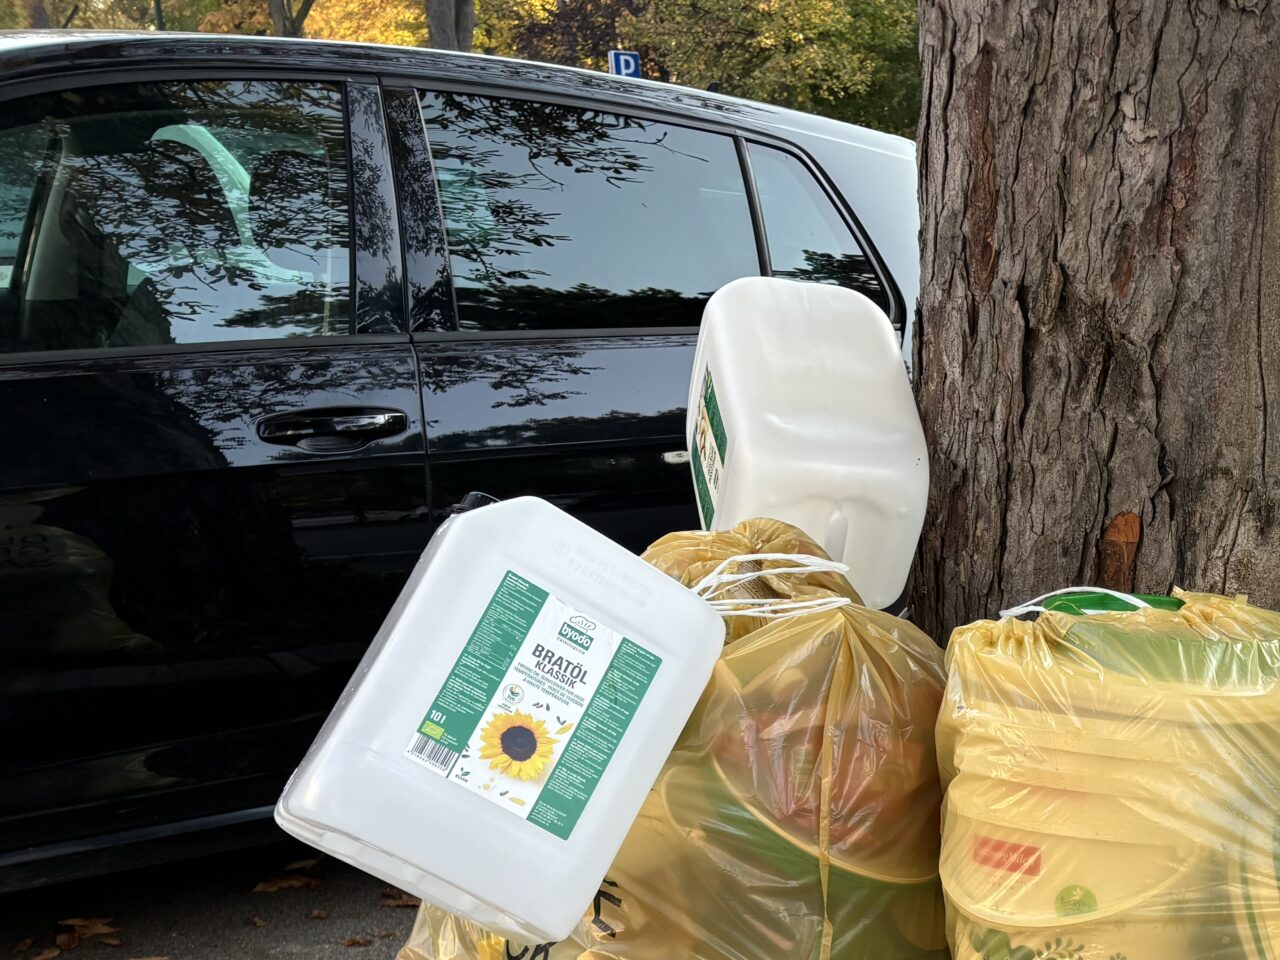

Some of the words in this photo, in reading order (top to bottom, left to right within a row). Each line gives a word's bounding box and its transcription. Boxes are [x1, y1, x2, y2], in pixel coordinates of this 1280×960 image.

[620, 55, 635, 77] P
[560, 624, 592, 649] byodo
[531, 643, 588, 686] BRATÖL
[534, 660, 577, 690] KLASSIK
[429, 709, 442, 723] 10
